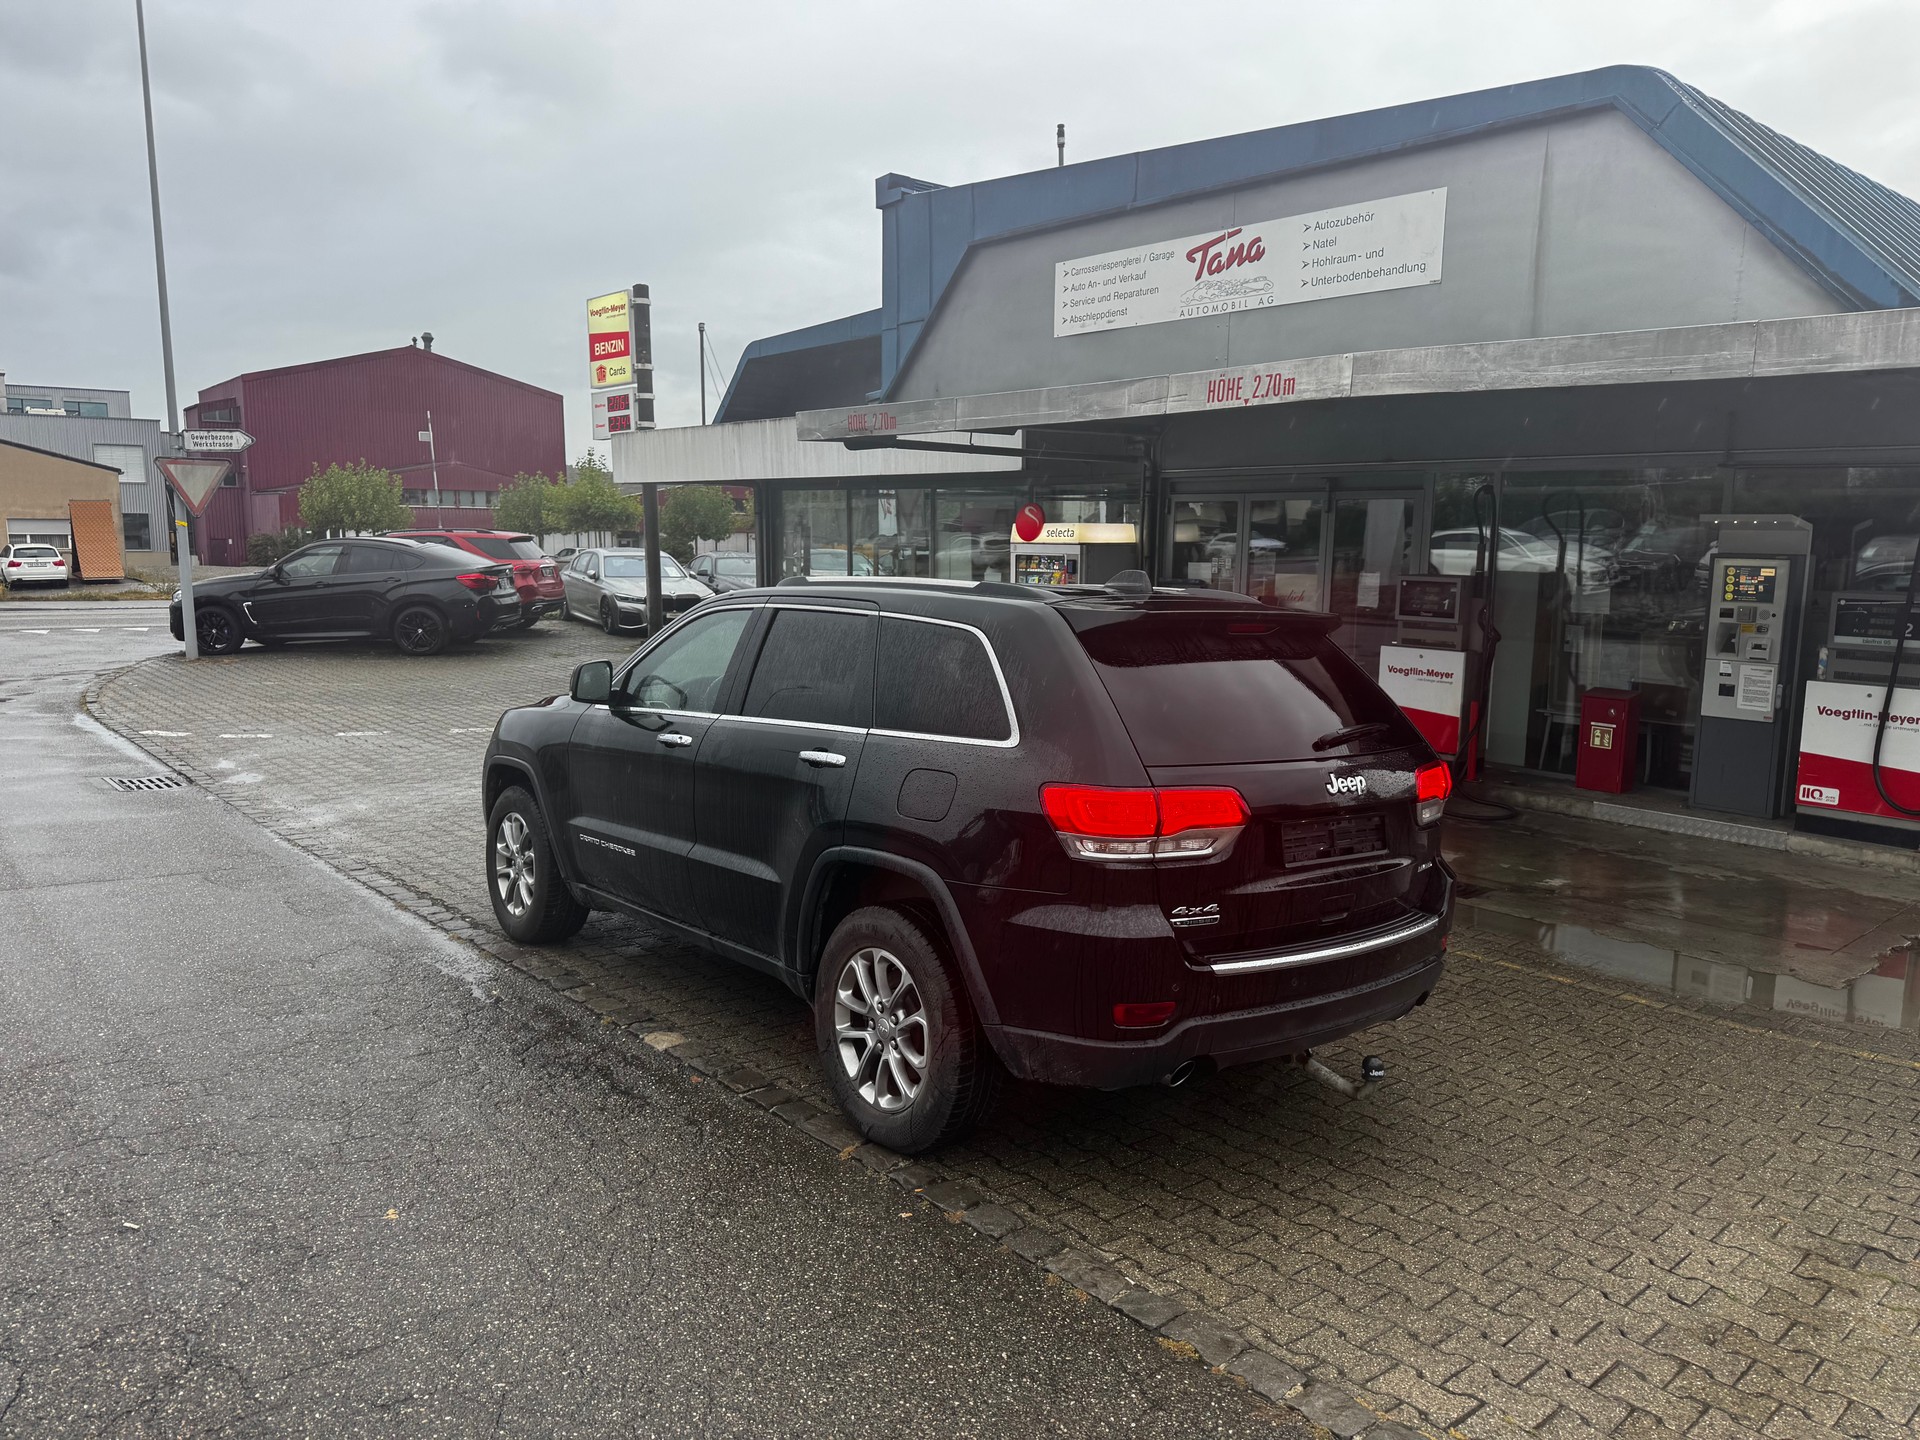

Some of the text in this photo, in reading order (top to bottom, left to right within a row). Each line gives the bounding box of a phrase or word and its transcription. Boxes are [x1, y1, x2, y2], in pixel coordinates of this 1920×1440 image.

[1313, 211, 1375, 231] Autozubehör
[1312, 236, 1337, 250] Natel
[1070, 256, 1142, 277] Carrosseriespenglerei
[1149, 250, 1175, 262] Garage
[1185, 227, 1266, 282] Tana
[1311, 247, 1385, 268] Hohlraum- und
[1070, 270, 1147, 293] Auto An- und Verkauf
[1310, 262, 1427, 287] Unterbodenbehandlung
[1069, 286, 1159, 308] Service und Reparaturen
[1179, 295, 1274, 318] AUTOMOBIL AG
[1069, 307, 1128, 324] Abschleppdienst
[594, 338, 625, 356] BENZIN
[609, 366, 626, 377] Cards
[1206, 373, 1244, 404] HÖHE
[192, 440, 233, 448] Werkstrasse
[1046, 527, 1075, 538] selecta
[1442, 598, 1449, 610] 1
[1904, 622, 1914, 637] 2
[1387, 664, 1455, 679] Voegtlin-Meyer
[1326, 772, 1367, 796] Jeep
[1171, 903, 1220, 915] 4x4
